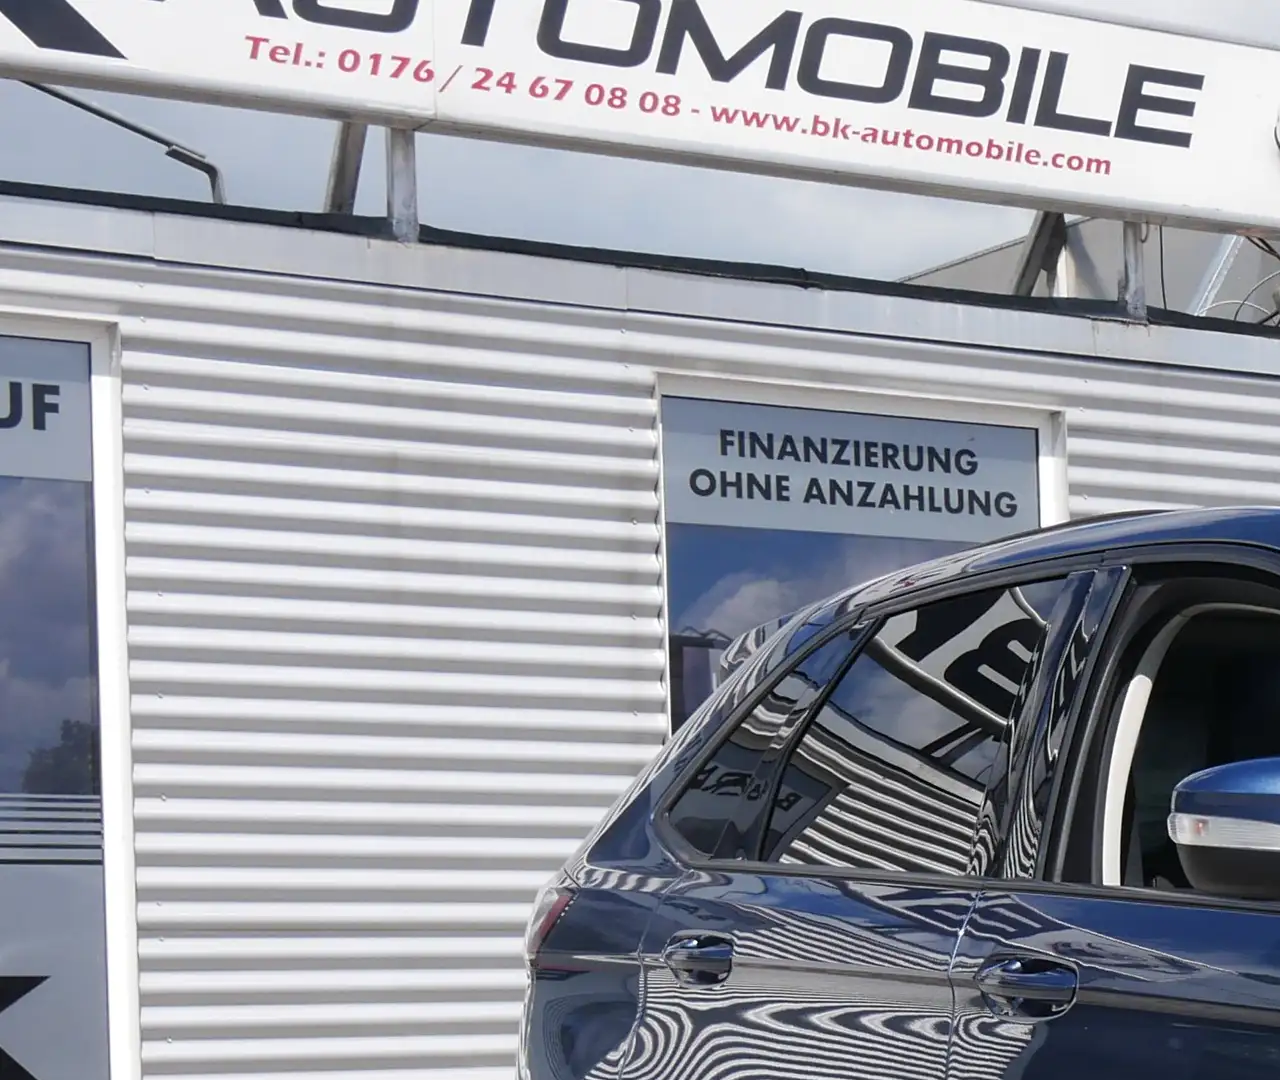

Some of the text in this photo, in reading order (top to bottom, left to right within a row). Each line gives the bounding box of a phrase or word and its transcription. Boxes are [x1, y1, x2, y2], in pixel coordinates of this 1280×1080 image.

[145, 0, 1204, 148] OMOBILE
[245, 36, 326, 68] Tel.:
[338, 49, 435, 83] 0176
[438, 65, 463, 93] /
[471, 67, 517, 94] 24
[528, 76, 574, 101] 67
[584, 84, 628, 109] 08
[639, 91, 681, 117] 08
[710, 104, 1112, 175] www.bk-automobile.com
[689, 468, 1018, 518] OHNE ANZAHLUNG
[720, 429, 979, 476] FINANZIERUNG
